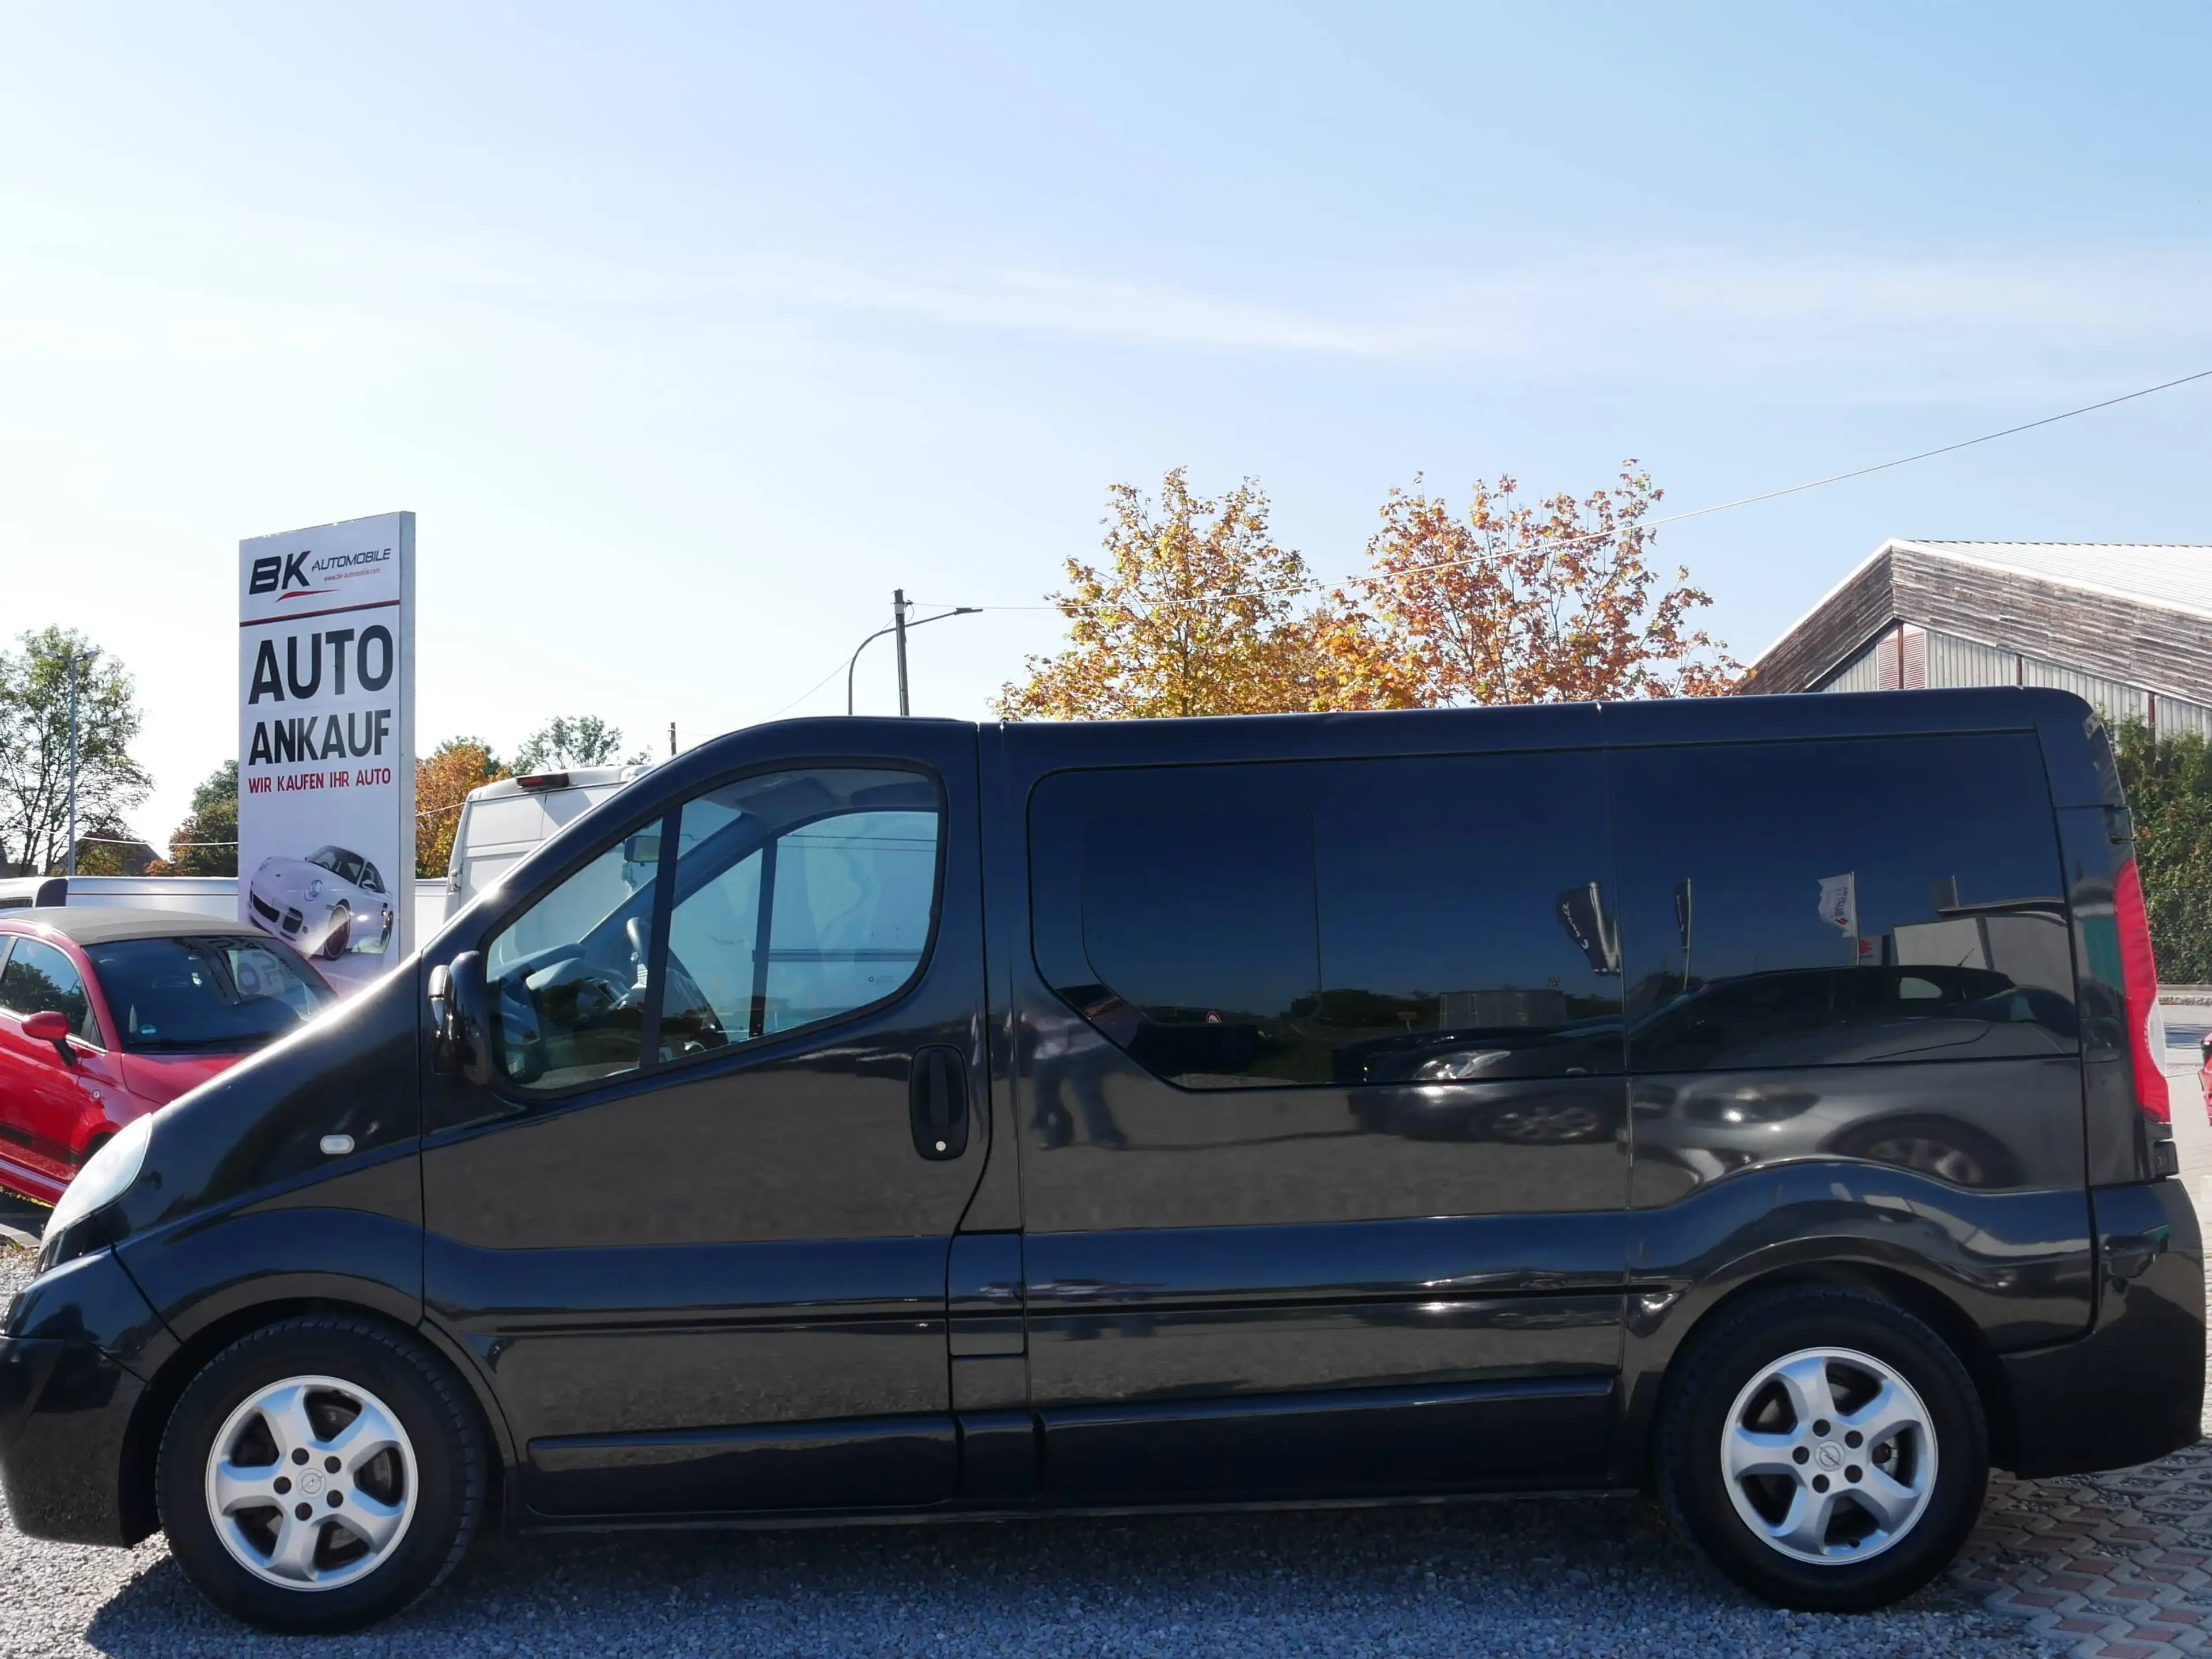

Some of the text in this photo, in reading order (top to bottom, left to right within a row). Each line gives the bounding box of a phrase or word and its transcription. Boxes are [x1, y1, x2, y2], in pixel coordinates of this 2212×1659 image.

[249, 548, 391, 594] BK AUTOMOBILE
[248, 625, 393, 704] AUTO
[248, 709, 391, 765] ANKAUF
[248, 767, 391, 794] WIR KAUFEN IHR AUTO
